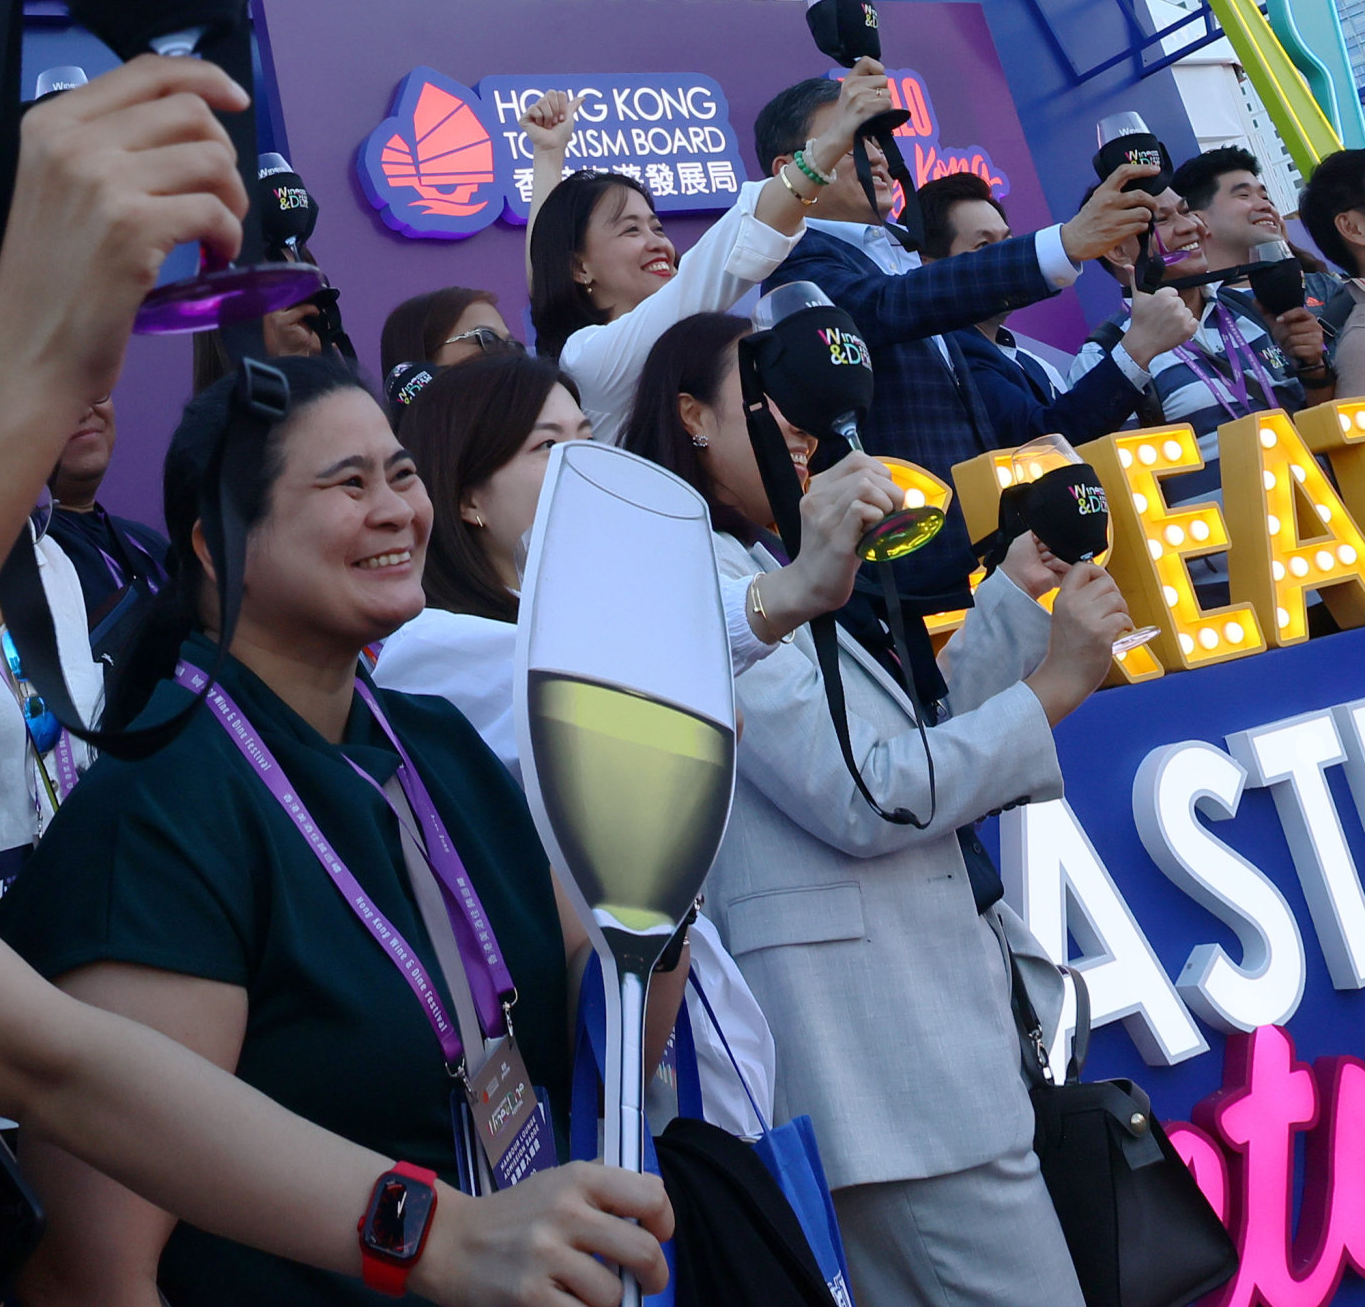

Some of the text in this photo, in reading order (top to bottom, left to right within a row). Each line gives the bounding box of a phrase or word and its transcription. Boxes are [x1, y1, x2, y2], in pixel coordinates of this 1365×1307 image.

[612, 86, 717, 123] KONG
[503, 126, 726, 160] TORISM BOARD
[830, 344, 848, 366] &
[245, 738, 272, 771] Festival
[355, 896, 373, 919] Hong
[372, 917, 391, 940] Kong
[389, 937, 408, 961] Wine
[411, 965, 427, 991] Dine
[424, 989, 448, 1033] Festival
